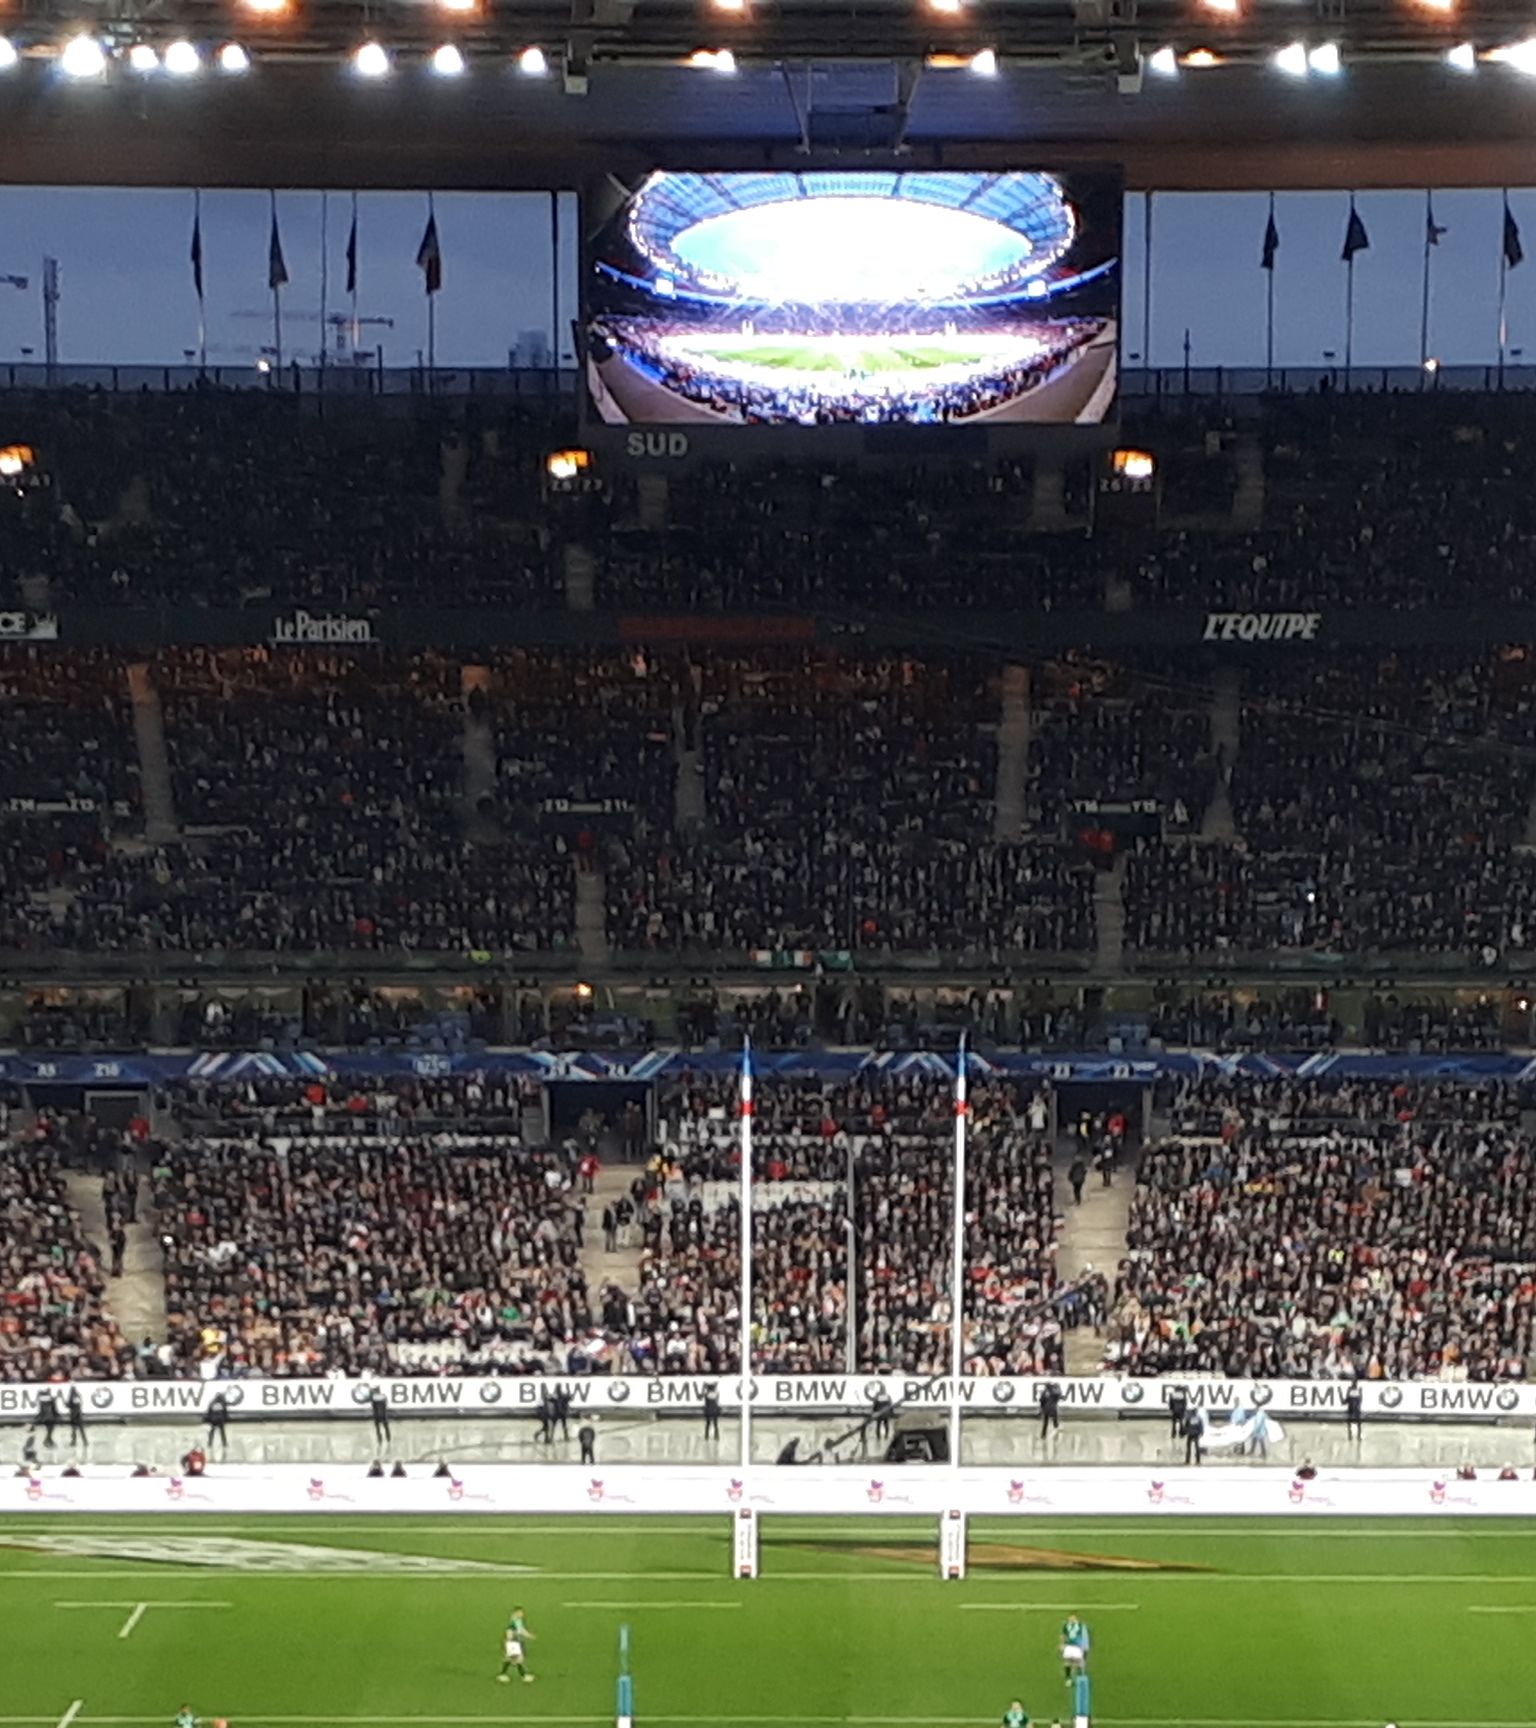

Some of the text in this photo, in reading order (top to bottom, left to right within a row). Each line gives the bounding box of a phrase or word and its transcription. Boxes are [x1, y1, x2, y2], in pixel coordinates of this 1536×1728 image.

[627, 432, 689, 457] SUD
[275, 609, 370, 641] Le Parisien
[130, 1385, 206, 1409] BMW
[262, 1384, 335, 1406] BMW
[390, 1382, 464, 1405] BMW
[775, 1380, 848, 1403] BMW
[1420, 1387, 1494, 1411] BMW
